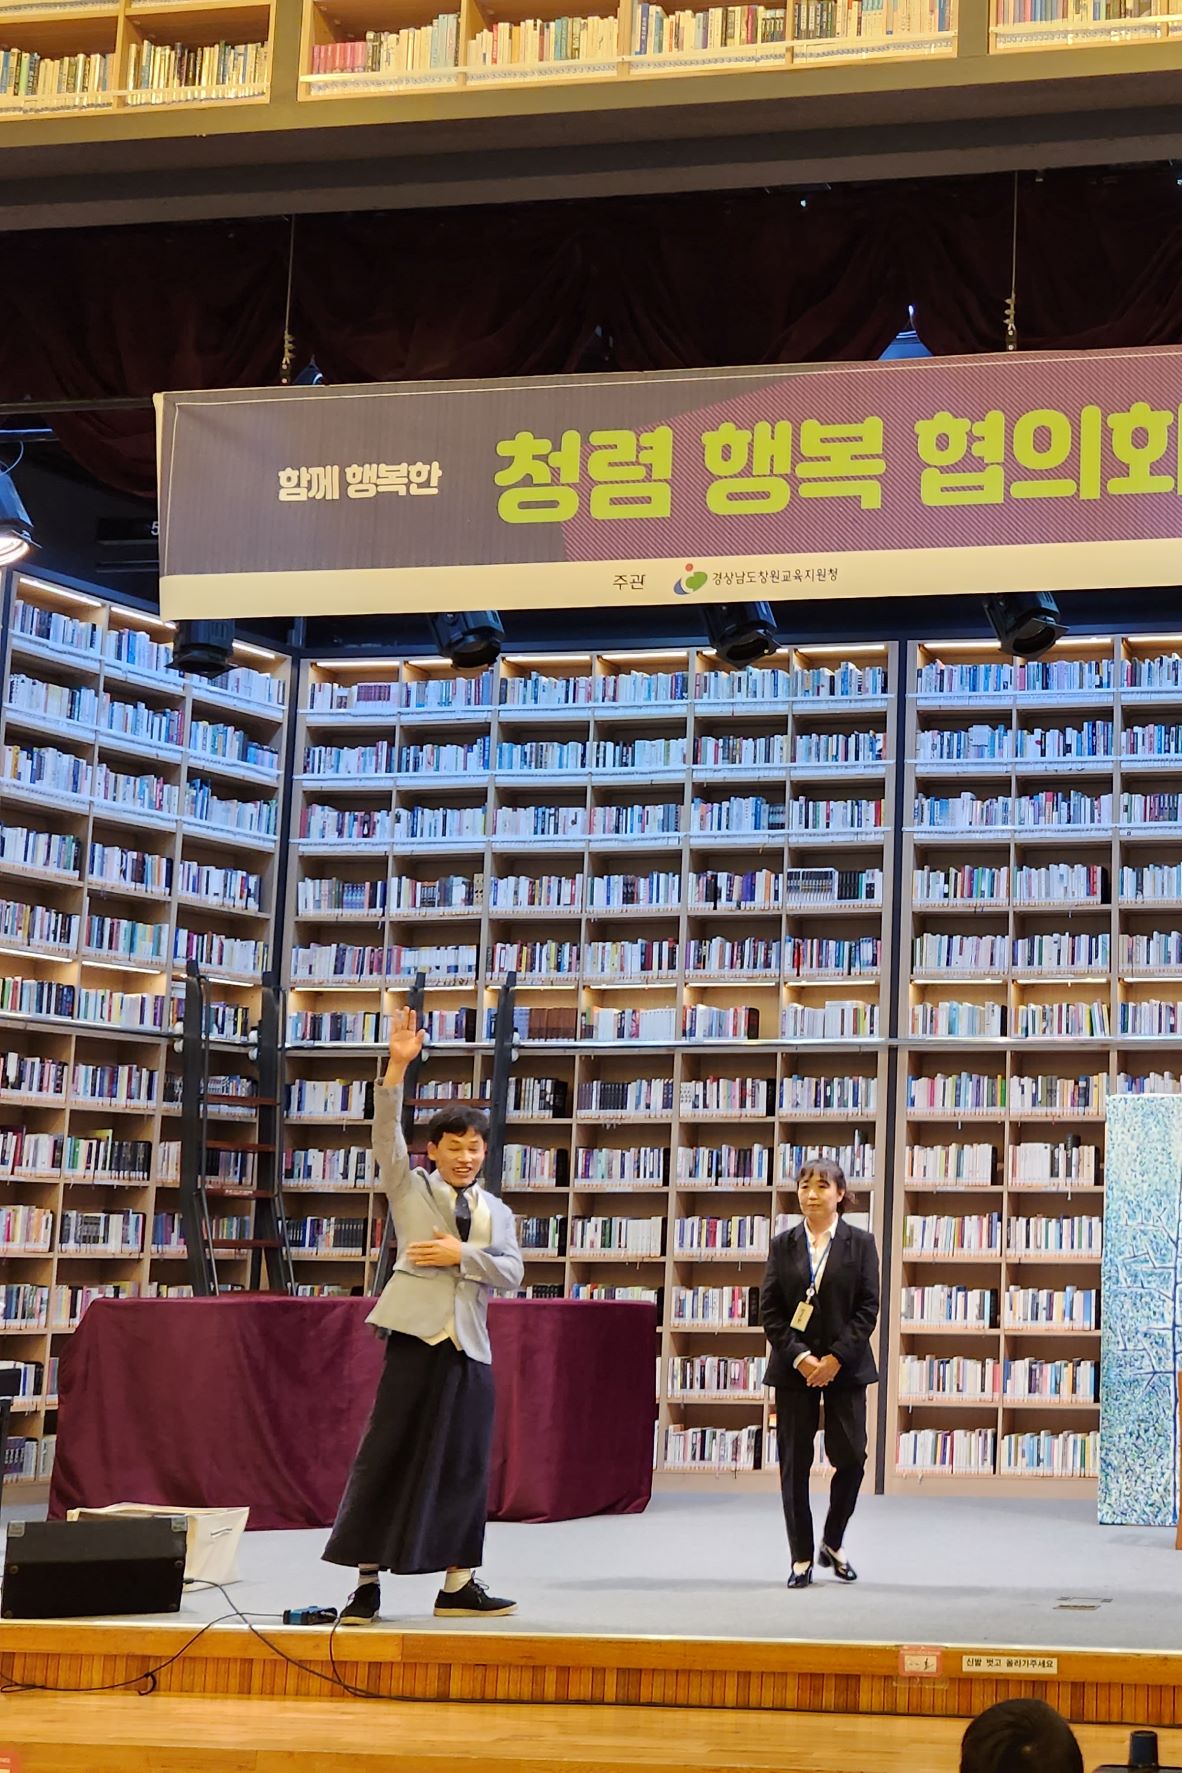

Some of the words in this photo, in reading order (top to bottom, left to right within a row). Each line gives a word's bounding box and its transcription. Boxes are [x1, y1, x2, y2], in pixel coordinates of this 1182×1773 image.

[277, 465, 337, 502] 함께
[344, 461, 443, 500] 행복한
[494, 425, 673, 525] 청렴
[701, 415, 887, 516] 행복
[612, 573, 646, 591] 주관
[712, 567, 839, 586] 경상남도창원교육지원청
[966, 1657, 982, 1668] 신발
[986, 1658, 1002, 1668] 벗고
